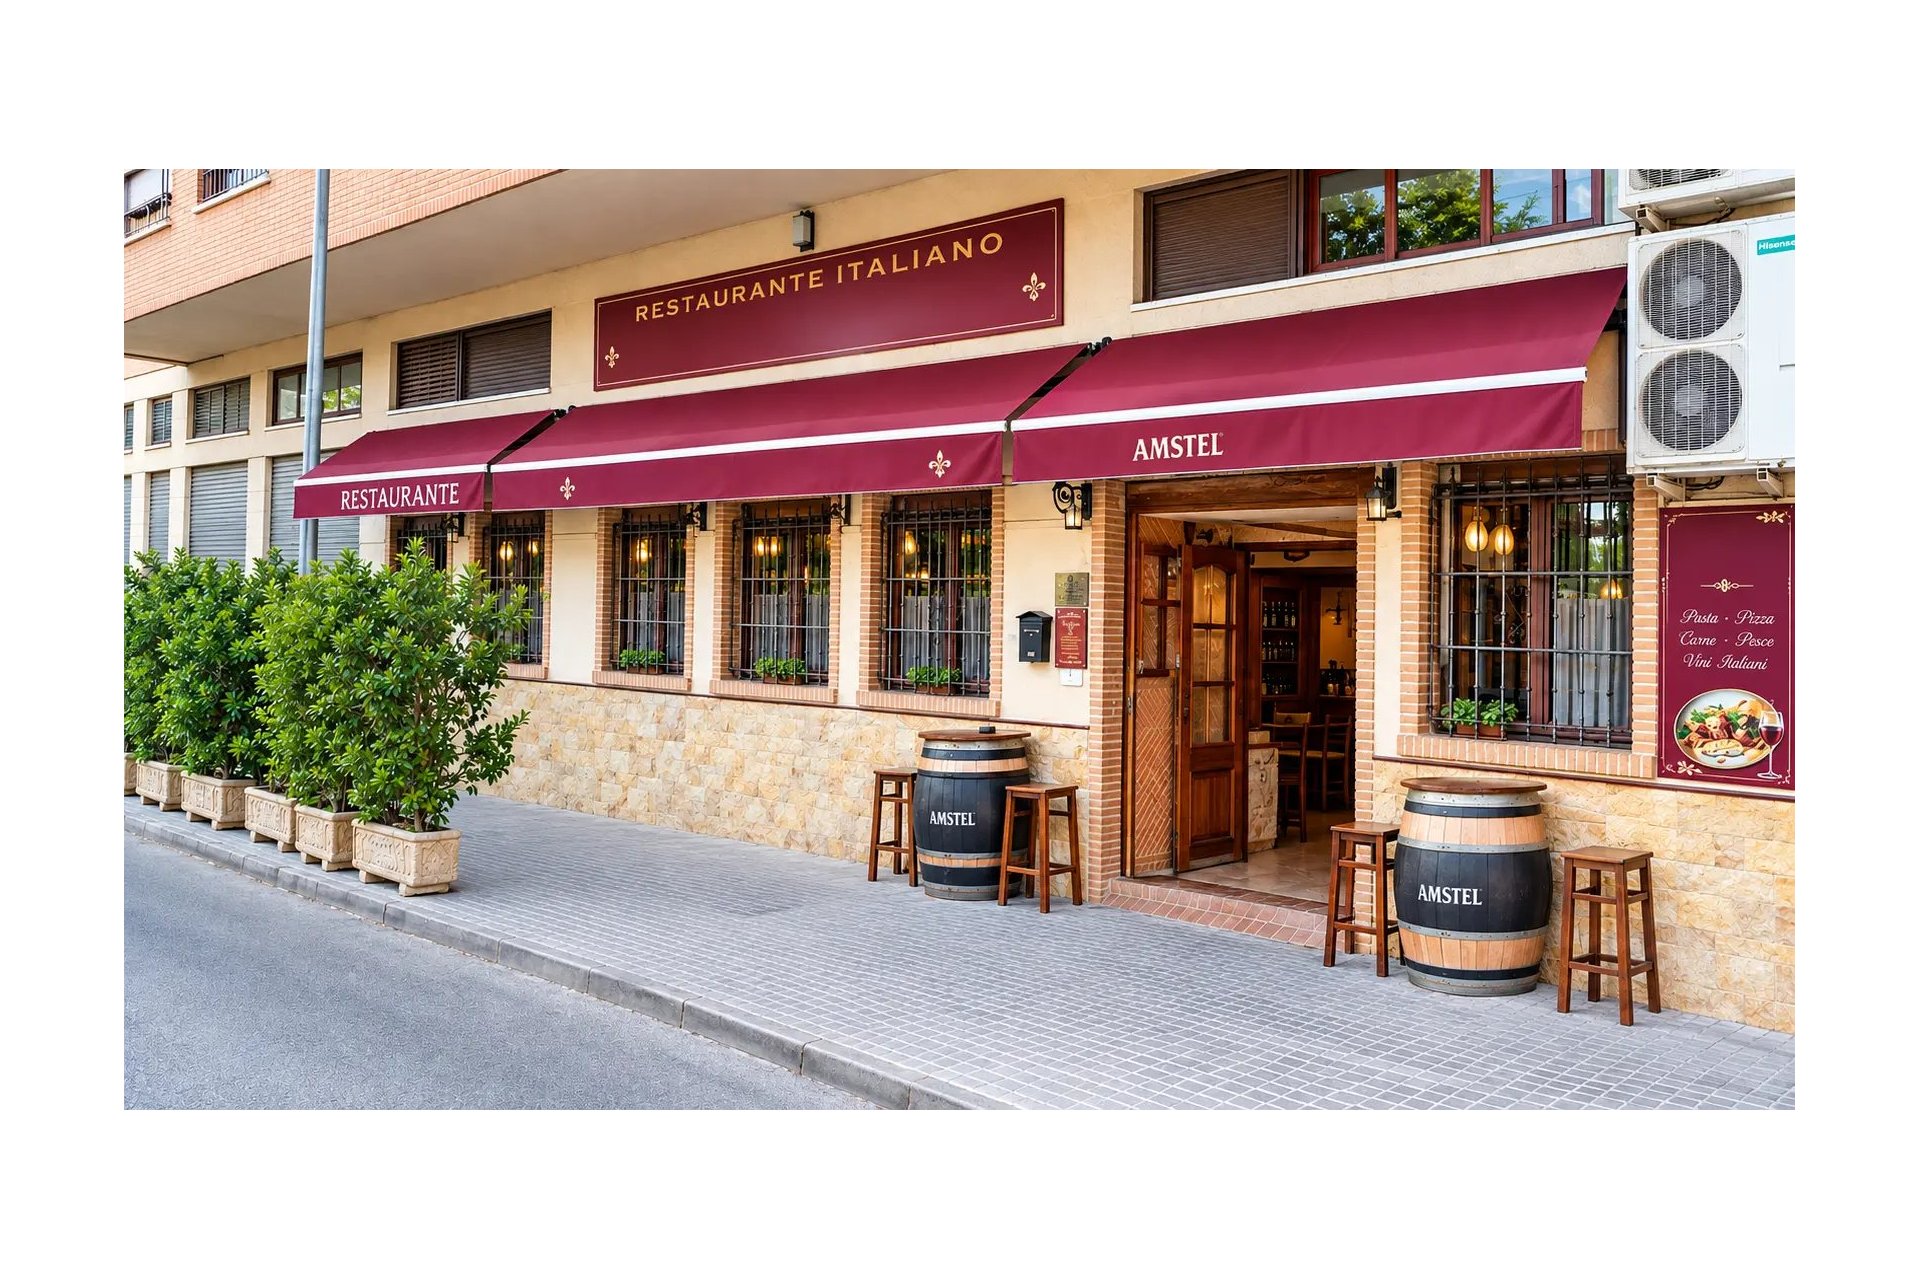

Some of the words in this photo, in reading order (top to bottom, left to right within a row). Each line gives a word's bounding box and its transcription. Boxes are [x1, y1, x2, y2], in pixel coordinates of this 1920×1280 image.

[634, 268, 824, 323] RESTAURANTE
[836, 232, 1004, 284] ITALIANO
[1132, 432, 1224, 461] AMSTEL
[340, 482, 460, 510] RESTAURANTE
[1680, 608, 1719, 624] Pasta
[1734, 609, 1775, 625] Pizza
[1679, 630, 1717, 646] Carne
[1735, 631, 1775, 647] Pesce
[1683, 653, 1712, 668] Vini
[1716, 654, 1768, 670] Italiani
[929, 810, 976, 826] AMSTEL
[1417, 884, 1483, 906] AMSTEL
